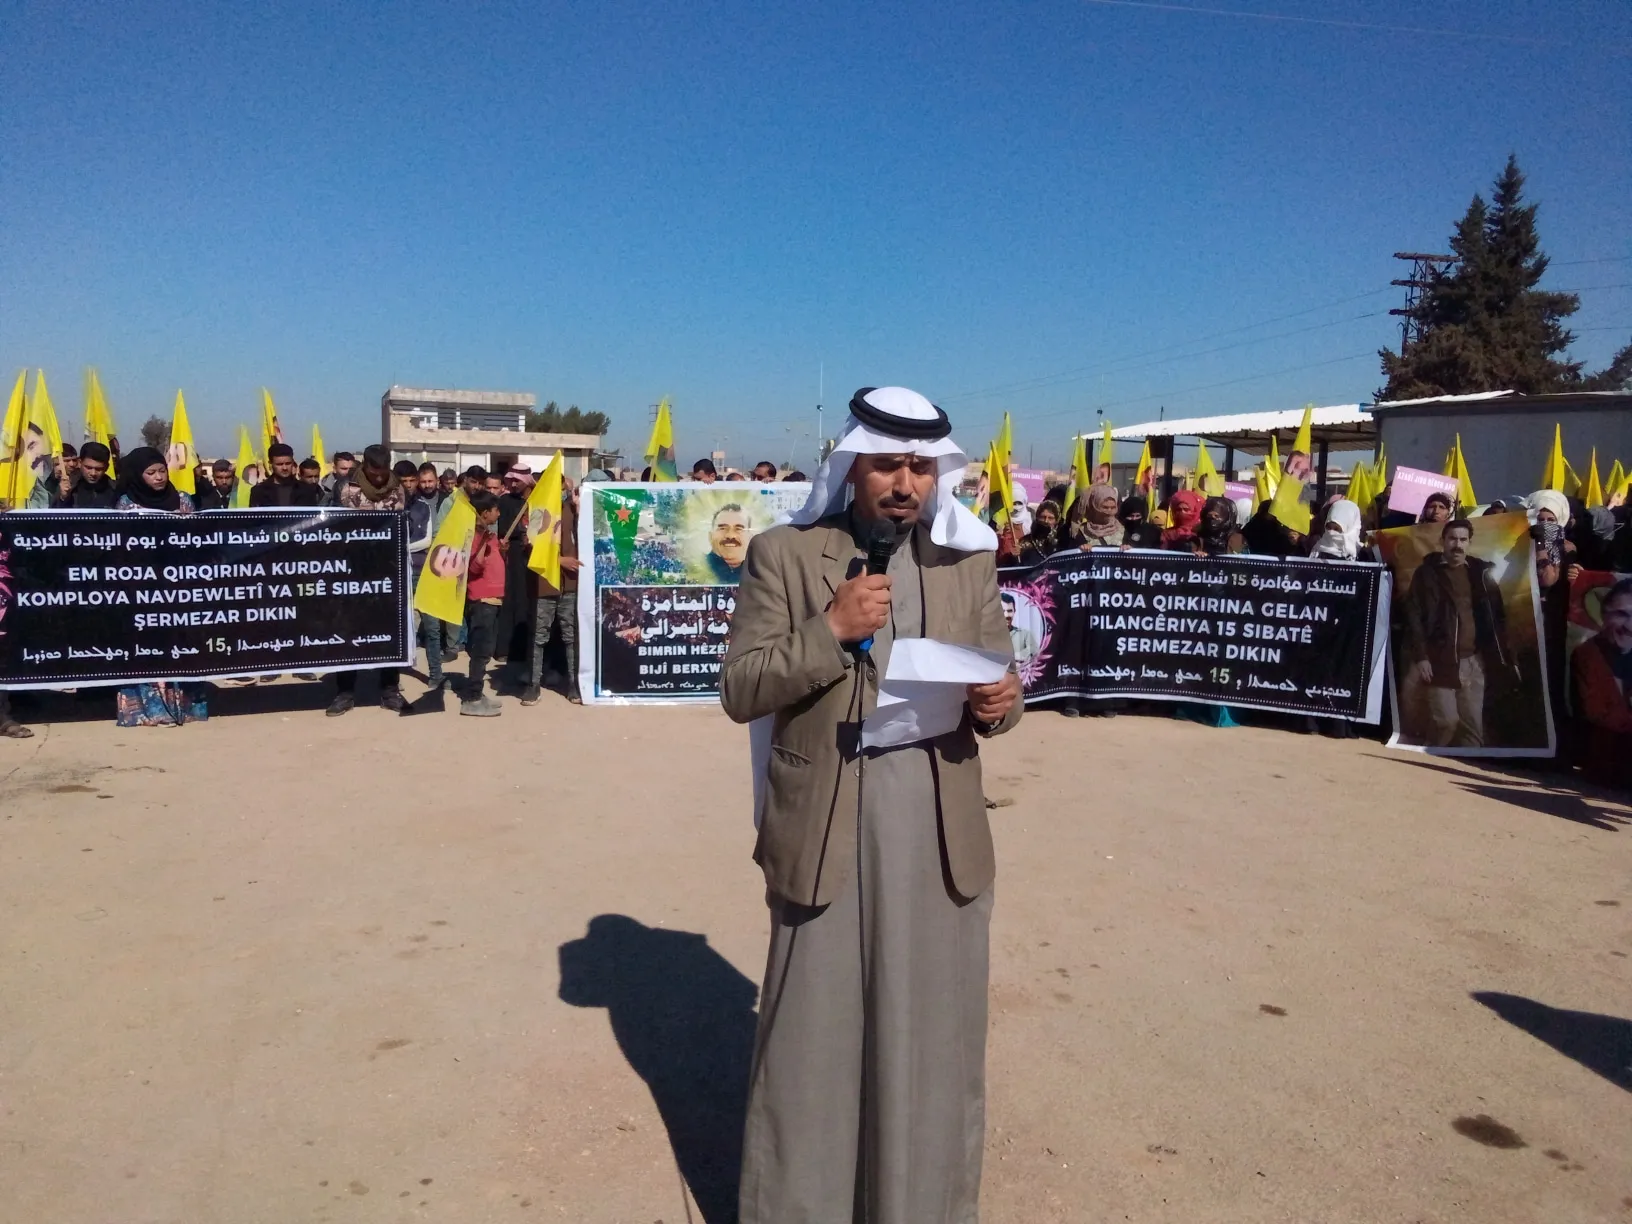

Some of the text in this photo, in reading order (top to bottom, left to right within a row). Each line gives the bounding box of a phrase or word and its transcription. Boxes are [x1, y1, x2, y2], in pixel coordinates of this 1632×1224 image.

[14, 534, 67, 550] الكردية
[73, 534, 120, 550] الإبادة
[126, 537, 156, 550] يوم
[168, 532, 222, 548] الدولية
[228, 530, 270, 547] شباط
[293, 527, 342, 545] مؤامرة
[345, 528, 391, 543] نستنكر
[69, 560, 351, 582] EM ROJA QIRQIRINA KURDAN,
[1058, 565, 1110, 585] الشعوب
[1114, 567, 1146, 585] إبادة
[1150, 572, 1176, 586] يوم
[1188, 570, 1228, 587] شباط
[1232, 574, 1246, 586] 15
[1251, 575, 1302, 592] مؤامرة
[1306, 579, 1356, 594] نستنكر
[18, 577, 392, 606] KOMPLOYA NAVDEWLETÎ YA 15Ê SIBATÊ
[1071, 593, 1092, 608] EM
[1100, 593, 1146, 608] ROJA
[1153, 595, 1254, 616] QIRKIRINA
[1262, 602, 1327, 621] GELAN
[135, 606, 296, 630] ŞERMEZAR DIKIN
[1090, 613, 1312, 643] PILANGÊRIYA 15 SIBATÊ
[639, 643, 729, 656] BIMRIN HÊZÊ
[1117, 637, 1280, 663] ŞERMEZAR DIKIN
[640, 662, 723, 674] BIJÎ BERXW
[1210, 667, 1229, 684] 15
